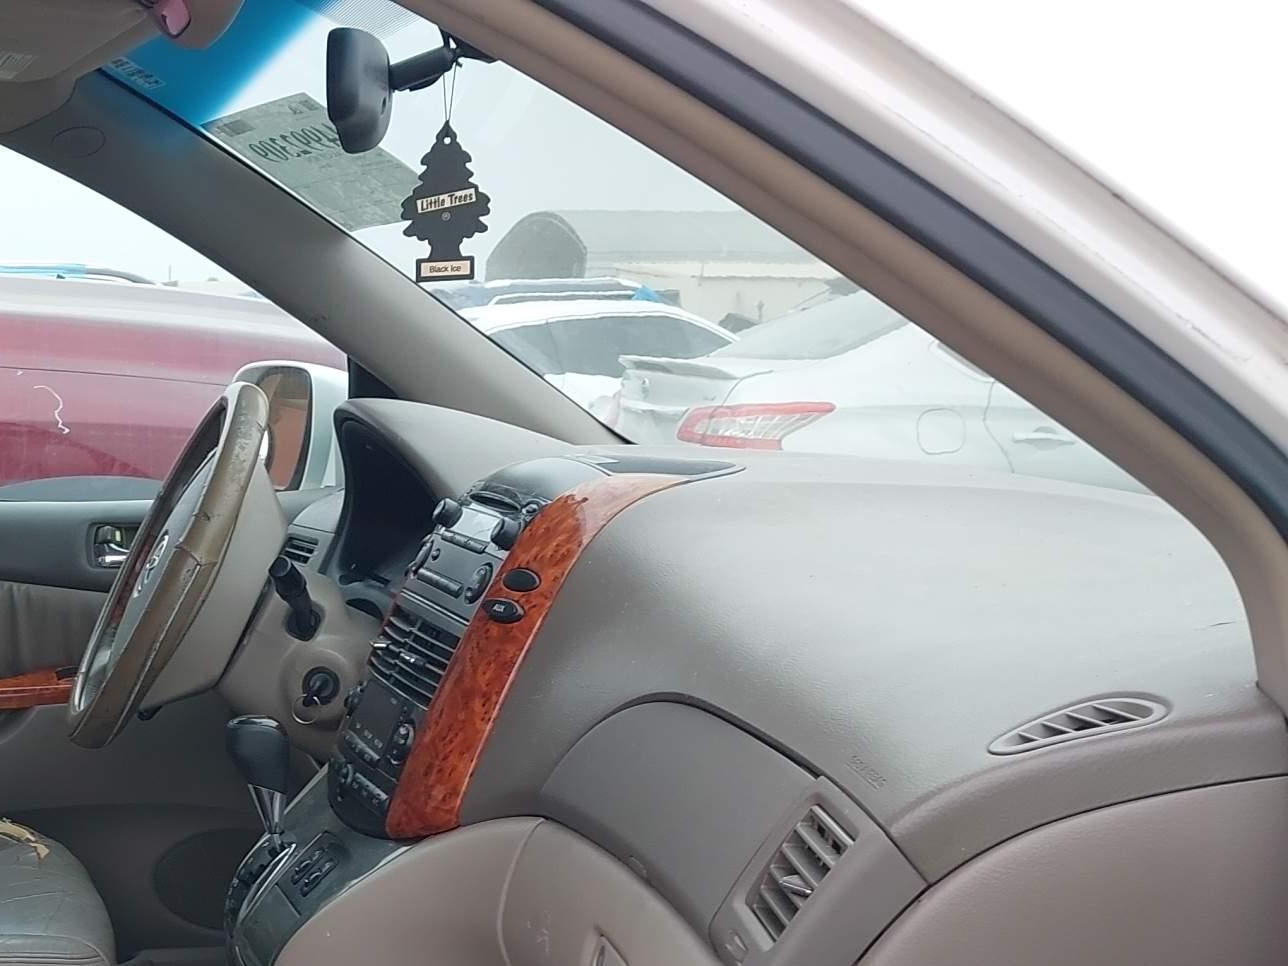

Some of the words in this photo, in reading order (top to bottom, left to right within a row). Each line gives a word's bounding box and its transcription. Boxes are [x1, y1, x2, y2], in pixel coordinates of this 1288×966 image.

[420, 196, 446, 212] Little
[448, 192, 473, 205] Trees
[429, 264, 449, 274] Black
[450, 264, 462, 273] Ice
